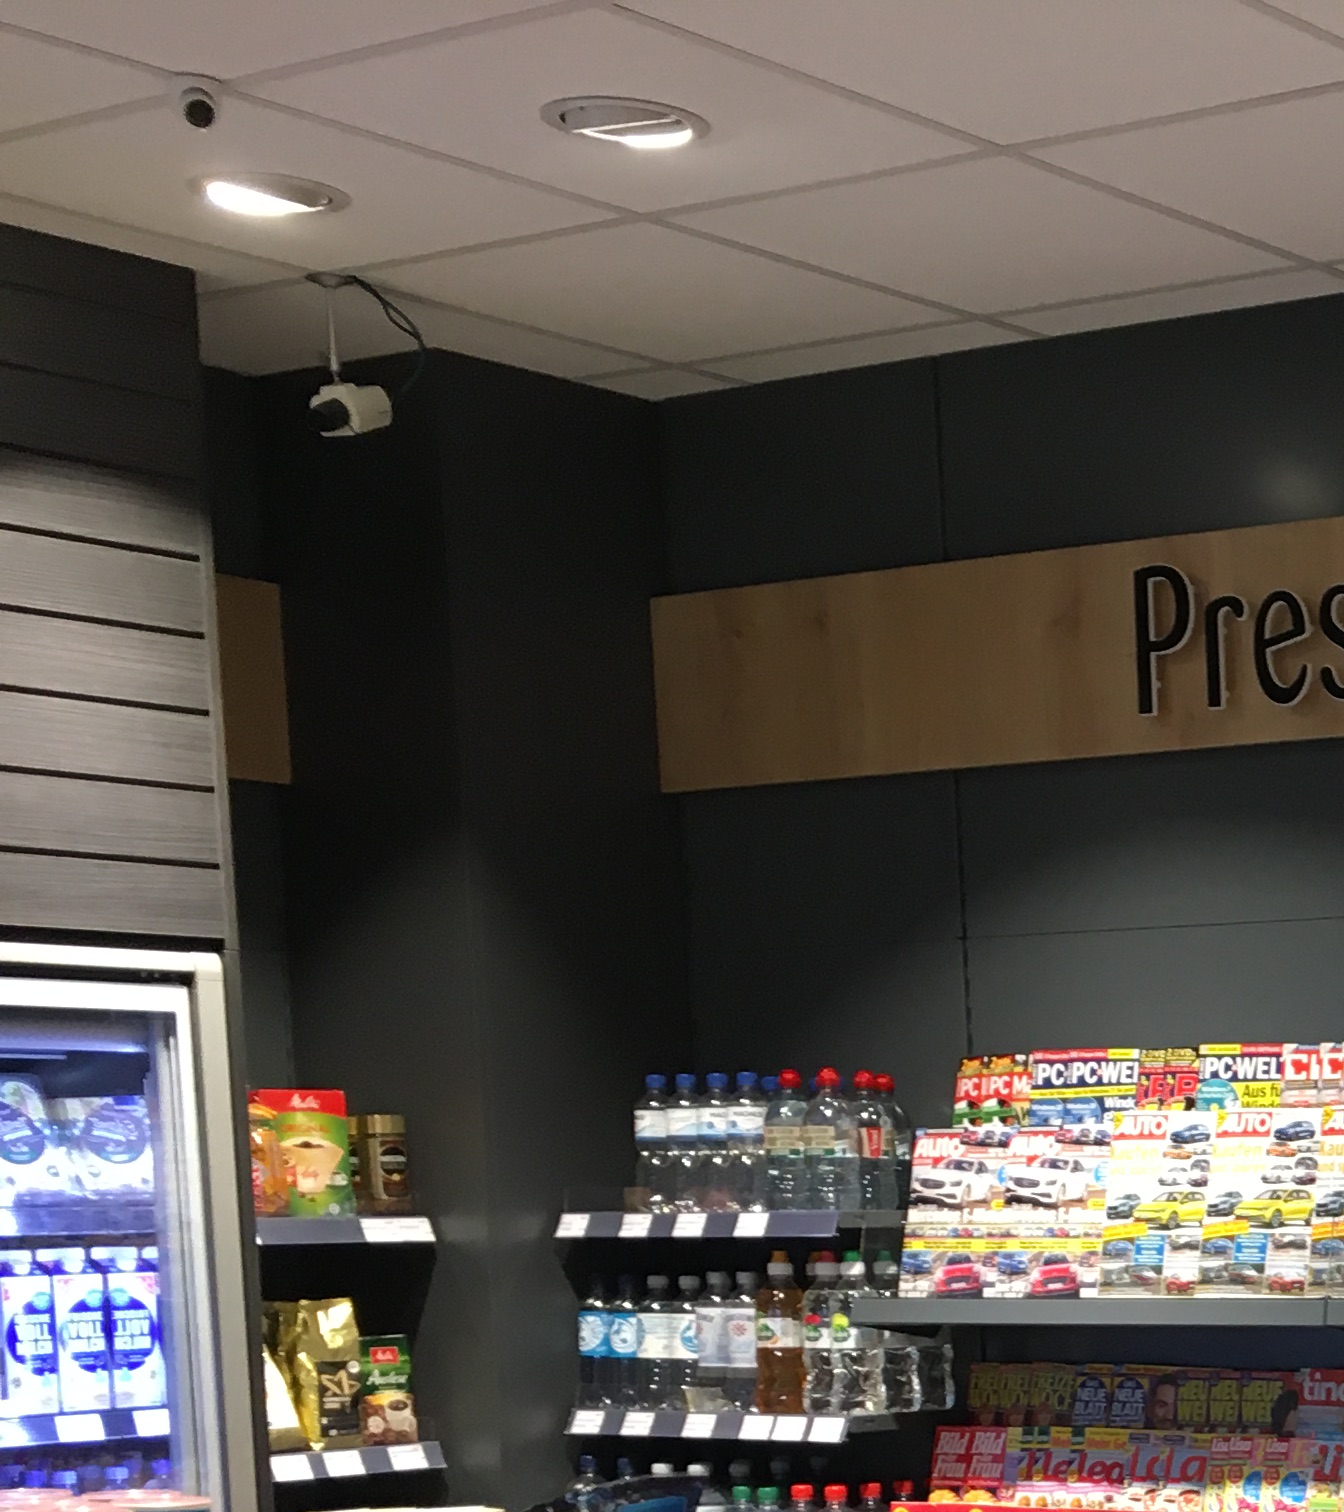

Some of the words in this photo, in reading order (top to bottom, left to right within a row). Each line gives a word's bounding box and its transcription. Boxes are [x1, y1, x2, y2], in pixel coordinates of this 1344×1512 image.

[1115, 1115, 1166, 1136] AUTO
[1218, 1113, 1272, 1135] AUTO
[1112, 1402, 1145, 1416] BLATT
[938, 1432, 970, 1454] Bild
[972, 1431, 1005, 1454] Bild
[969, 1461, 1002, 1479] Frau
